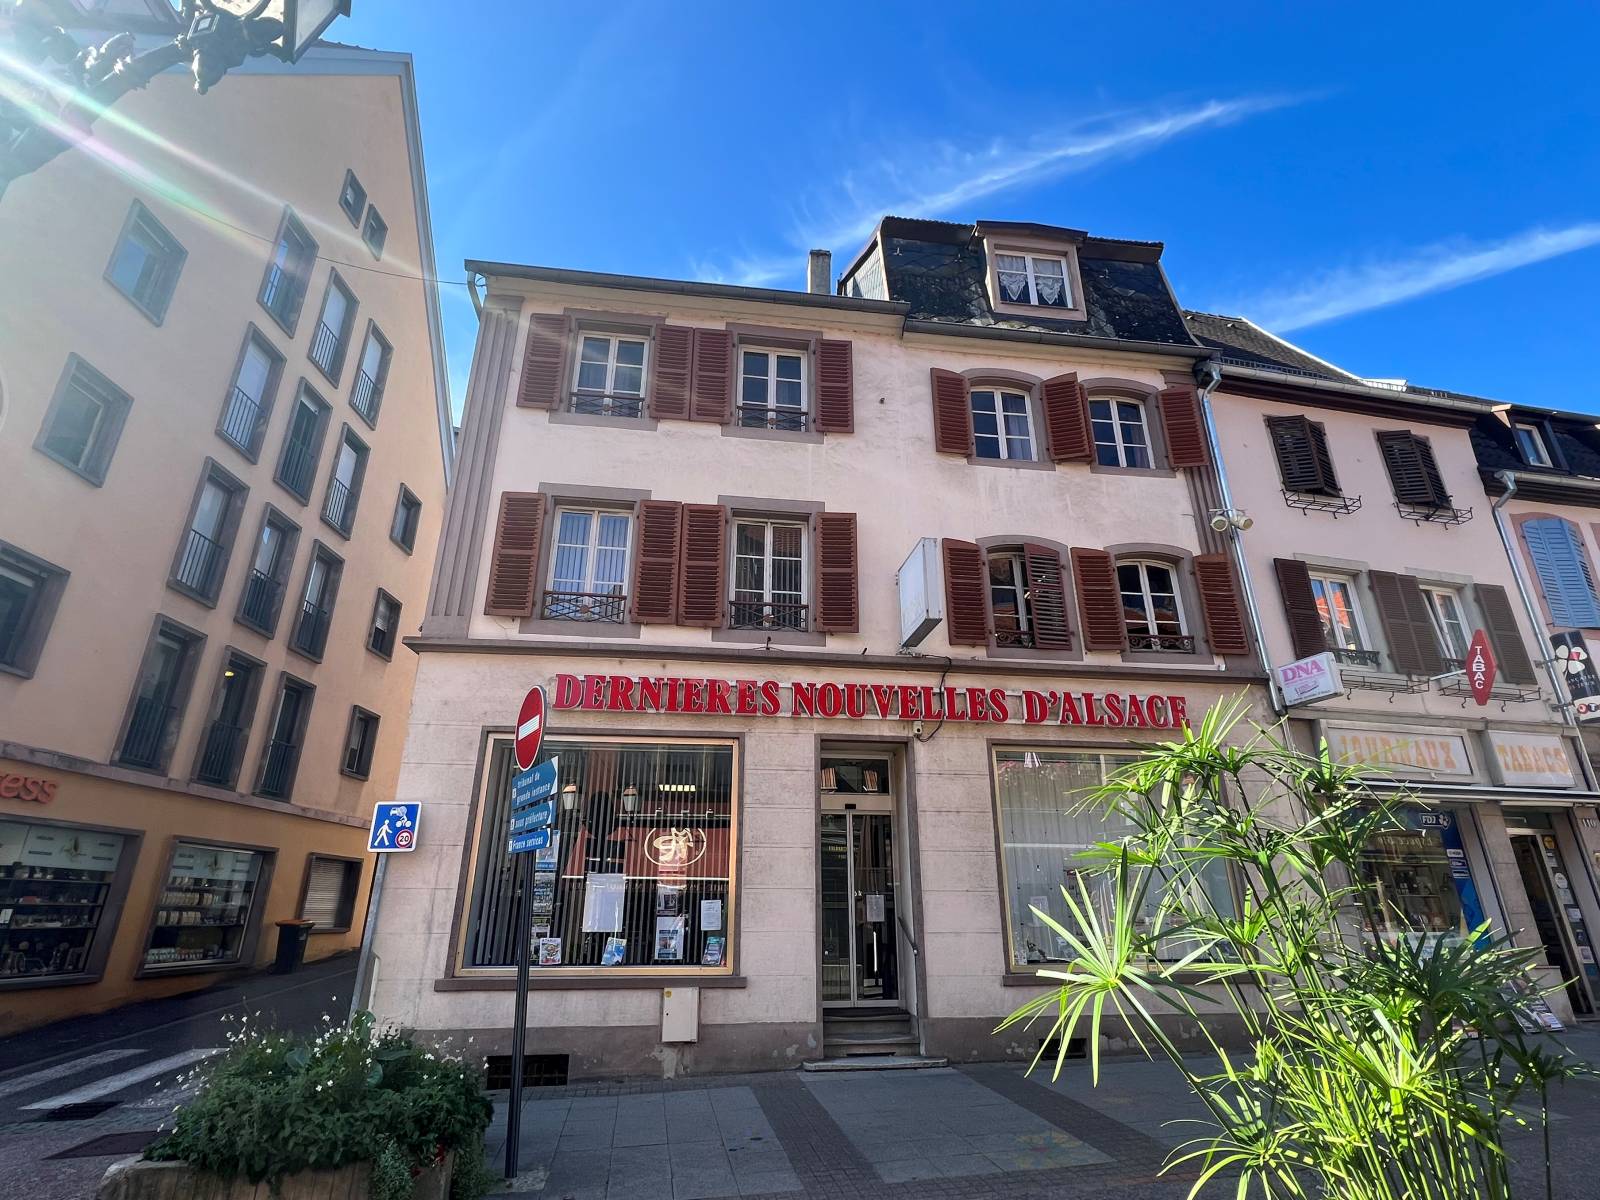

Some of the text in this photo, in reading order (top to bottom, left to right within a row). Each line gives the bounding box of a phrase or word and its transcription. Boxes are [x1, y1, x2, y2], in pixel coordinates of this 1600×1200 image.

[1280, 659, 1325, 682] DNA
[1472, 645, 1486, 689] TABAC
[552, 673, 1191, 729] DERNIERES NOUVELLES D'ALSACE
[1338, 734, 1457, 770] JOURNAUX
[1496, 744, 1569, 774] TABACS
[517, 771, 540, 787] tribunal de
[516, 782, 551, 806] grande instance
[514, 810, 548, 828] sous préfecture
[1422, 815, 1436, 824] FDJ
[399, 835, 410, 843] 20
[512, 836, 544, 850] France services
